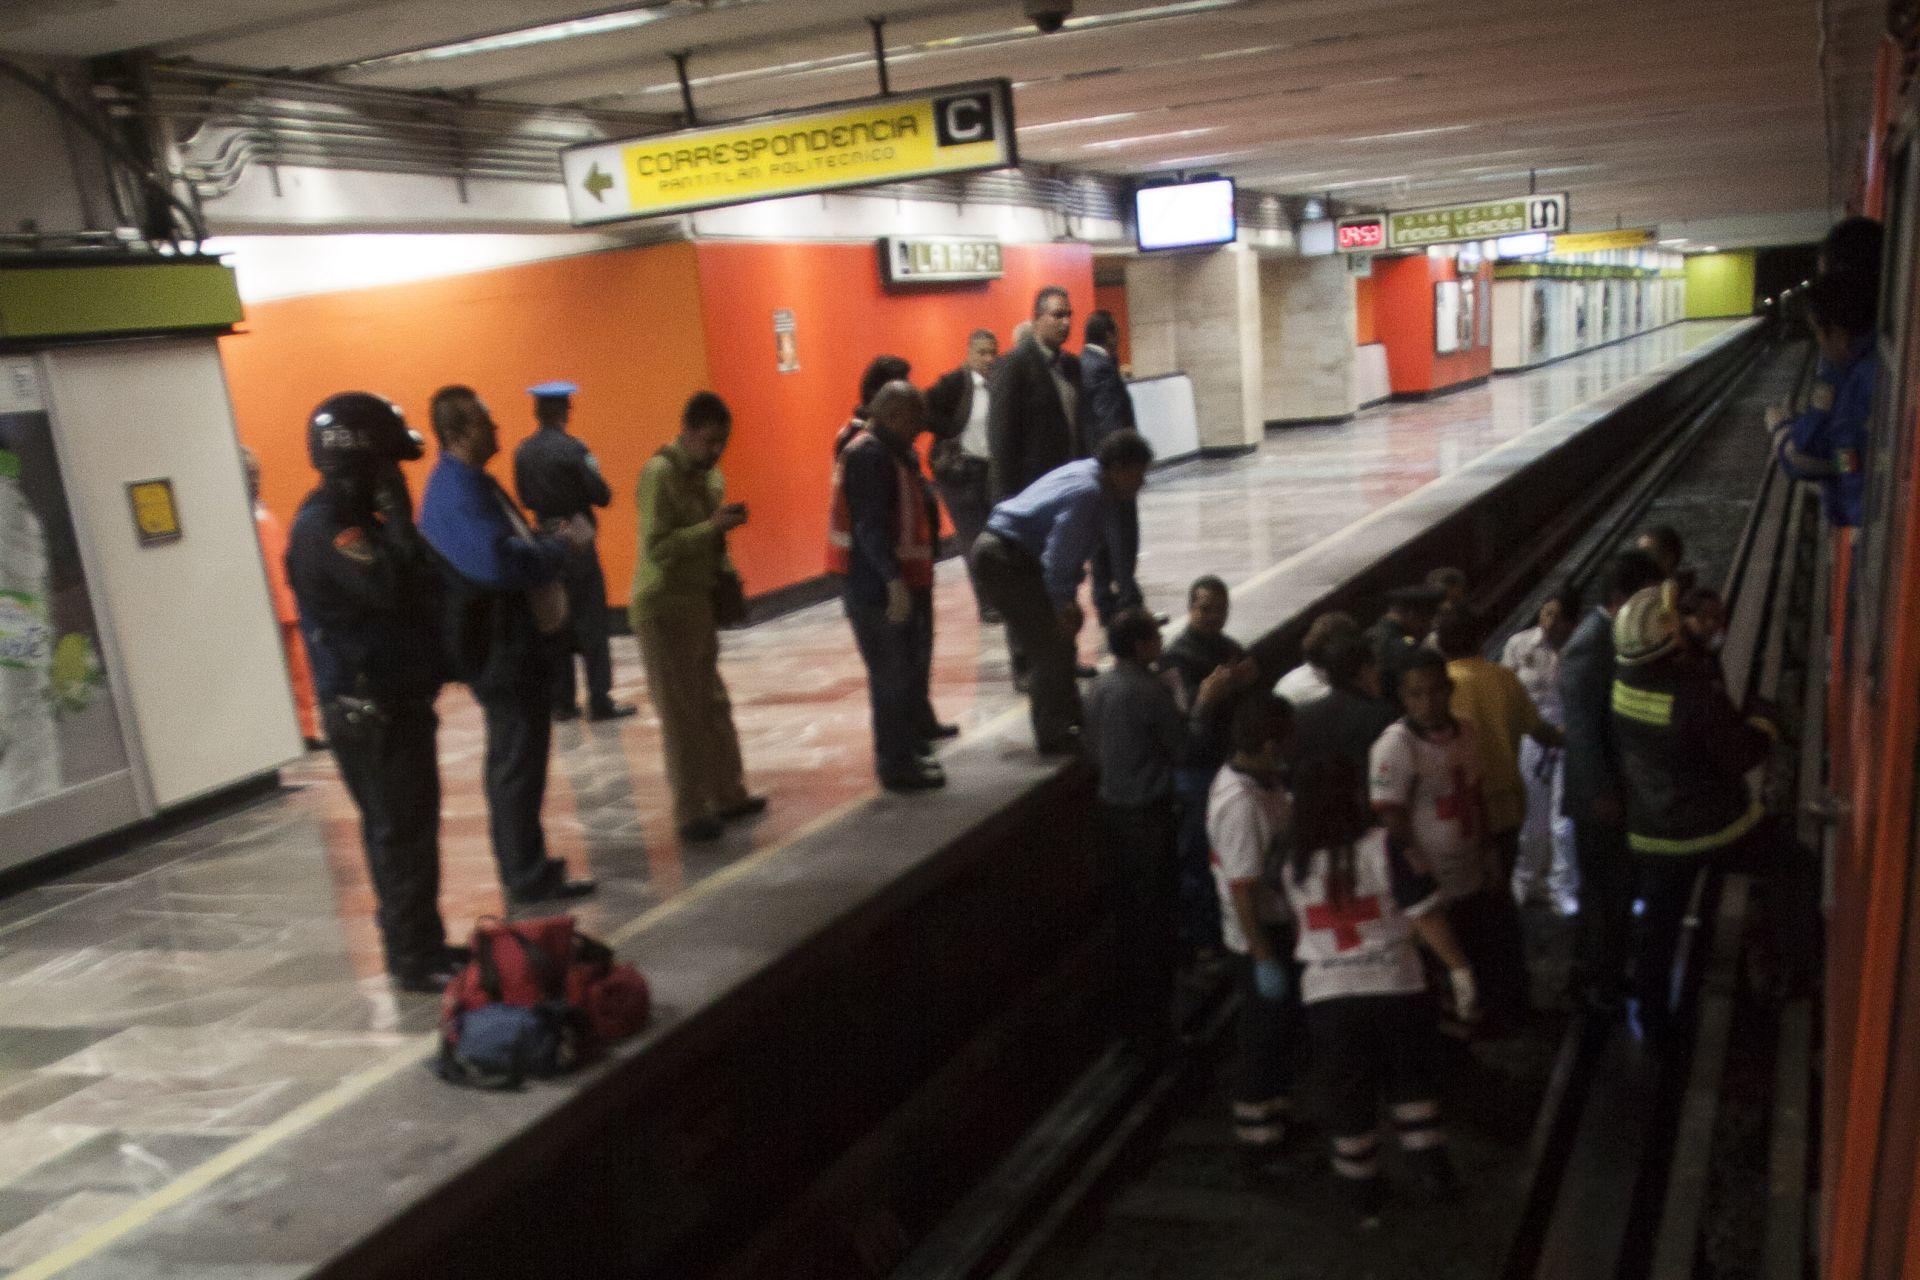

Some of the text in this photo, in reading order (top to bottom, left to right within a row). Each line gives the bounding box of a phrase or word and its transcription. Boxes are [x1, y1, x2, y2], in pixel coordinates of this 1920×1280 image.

[947, 98, 985, 140] C
[637, 115, 919, 176] CORRESPONDENCIA
[915, 243, 945, 273] LA
